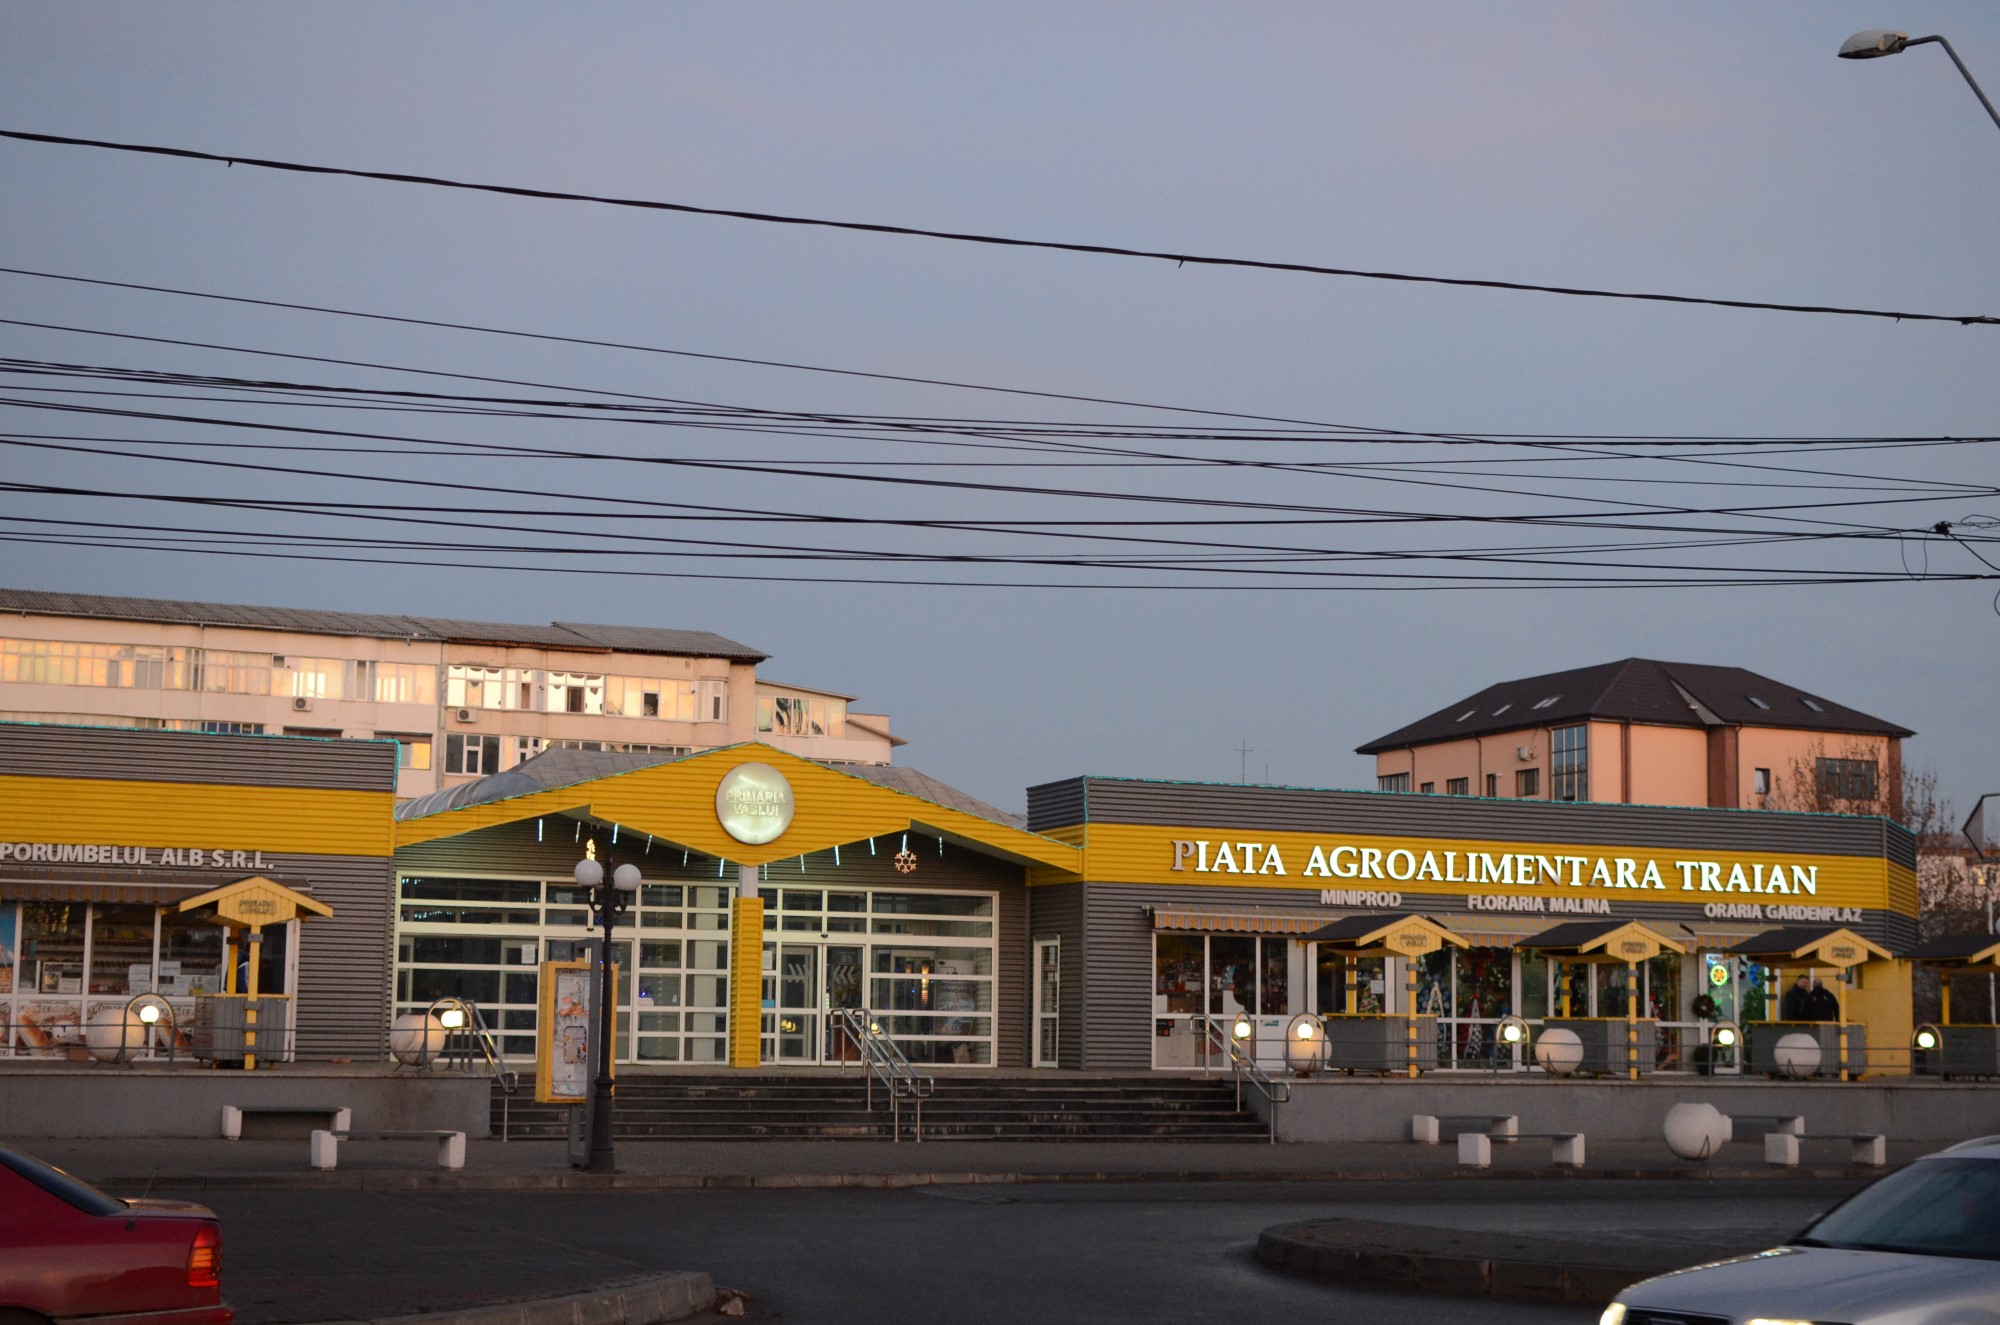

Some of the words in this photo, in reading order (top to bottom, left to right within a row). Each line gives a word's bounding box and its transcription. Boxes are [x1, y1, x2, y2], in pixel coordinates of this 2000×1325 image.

[725, 788, 785, 804] PRIMARIA
[733, 803, 779, 817] VASLUI
[0, 842, 152, 866] PORUMBELUL
[160, 848, 204, 867] ALB
[211, 850, 275, 870] S.R.L.
[1171, 840, 1287, 876] PIATA
[1302, 845, 1666, 890] AGROALIMENTARA
[1675, 861, 1818, 896] TRAIAN
[1320, 889, 1402, 908] MINIPROD
[1467, 894, 1544, 912] FLORARIA
[1549, 898, 1611, 914] MALINA
[1704, 903, 1763, 920] ORARIA
[1765, 904, 1862, 922] GARDENPLAZ
